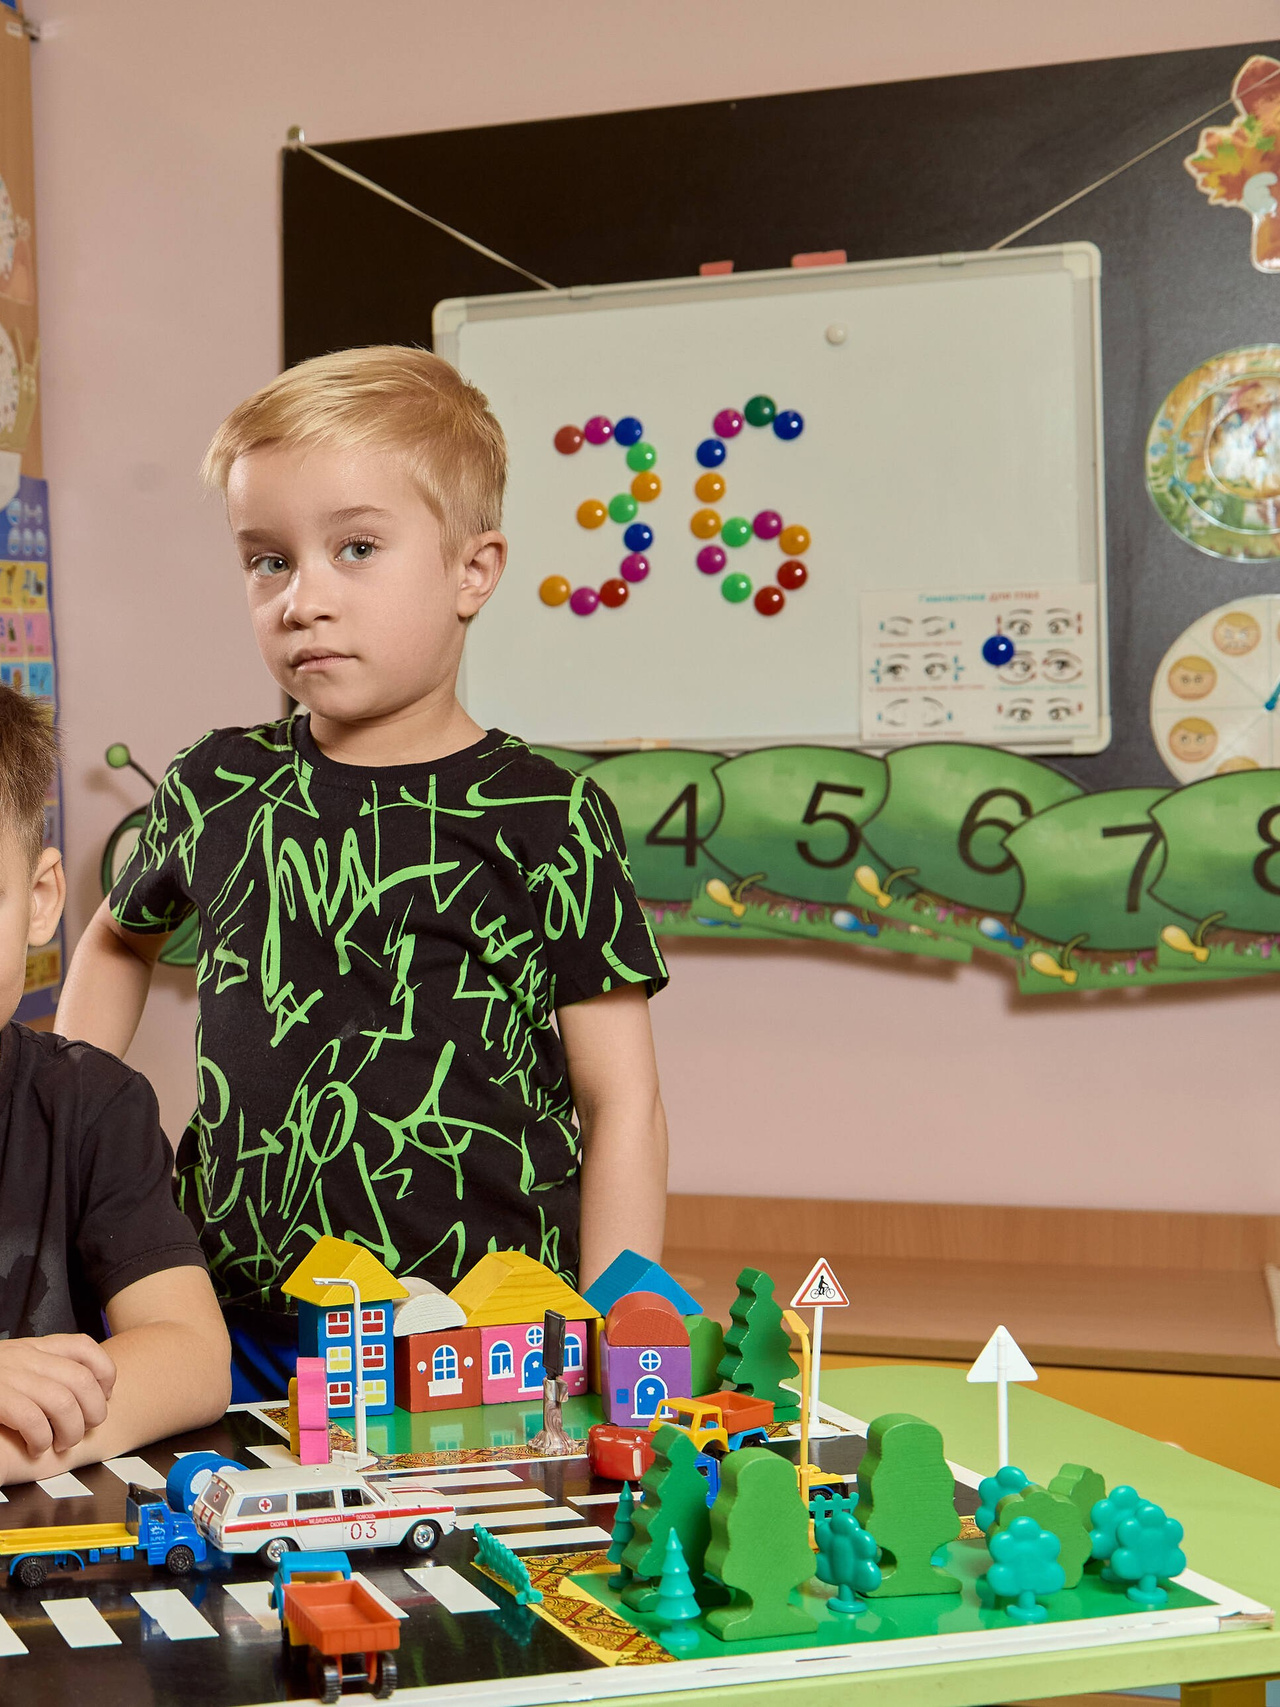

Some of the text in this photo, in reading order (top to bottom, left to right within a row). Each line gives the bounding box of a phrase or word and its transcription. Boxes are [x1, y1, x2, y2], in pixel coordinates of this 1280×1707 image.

[644, 782, 699, 867] 4
[796, 780, 865, 869] 5
[957, 787, 1034, 875] 6
[1101, 822, 1165, 913] 7
[269, 1520, 289, 1528] СКОРАЯ
[350, 1520, 377, 1540] 03
